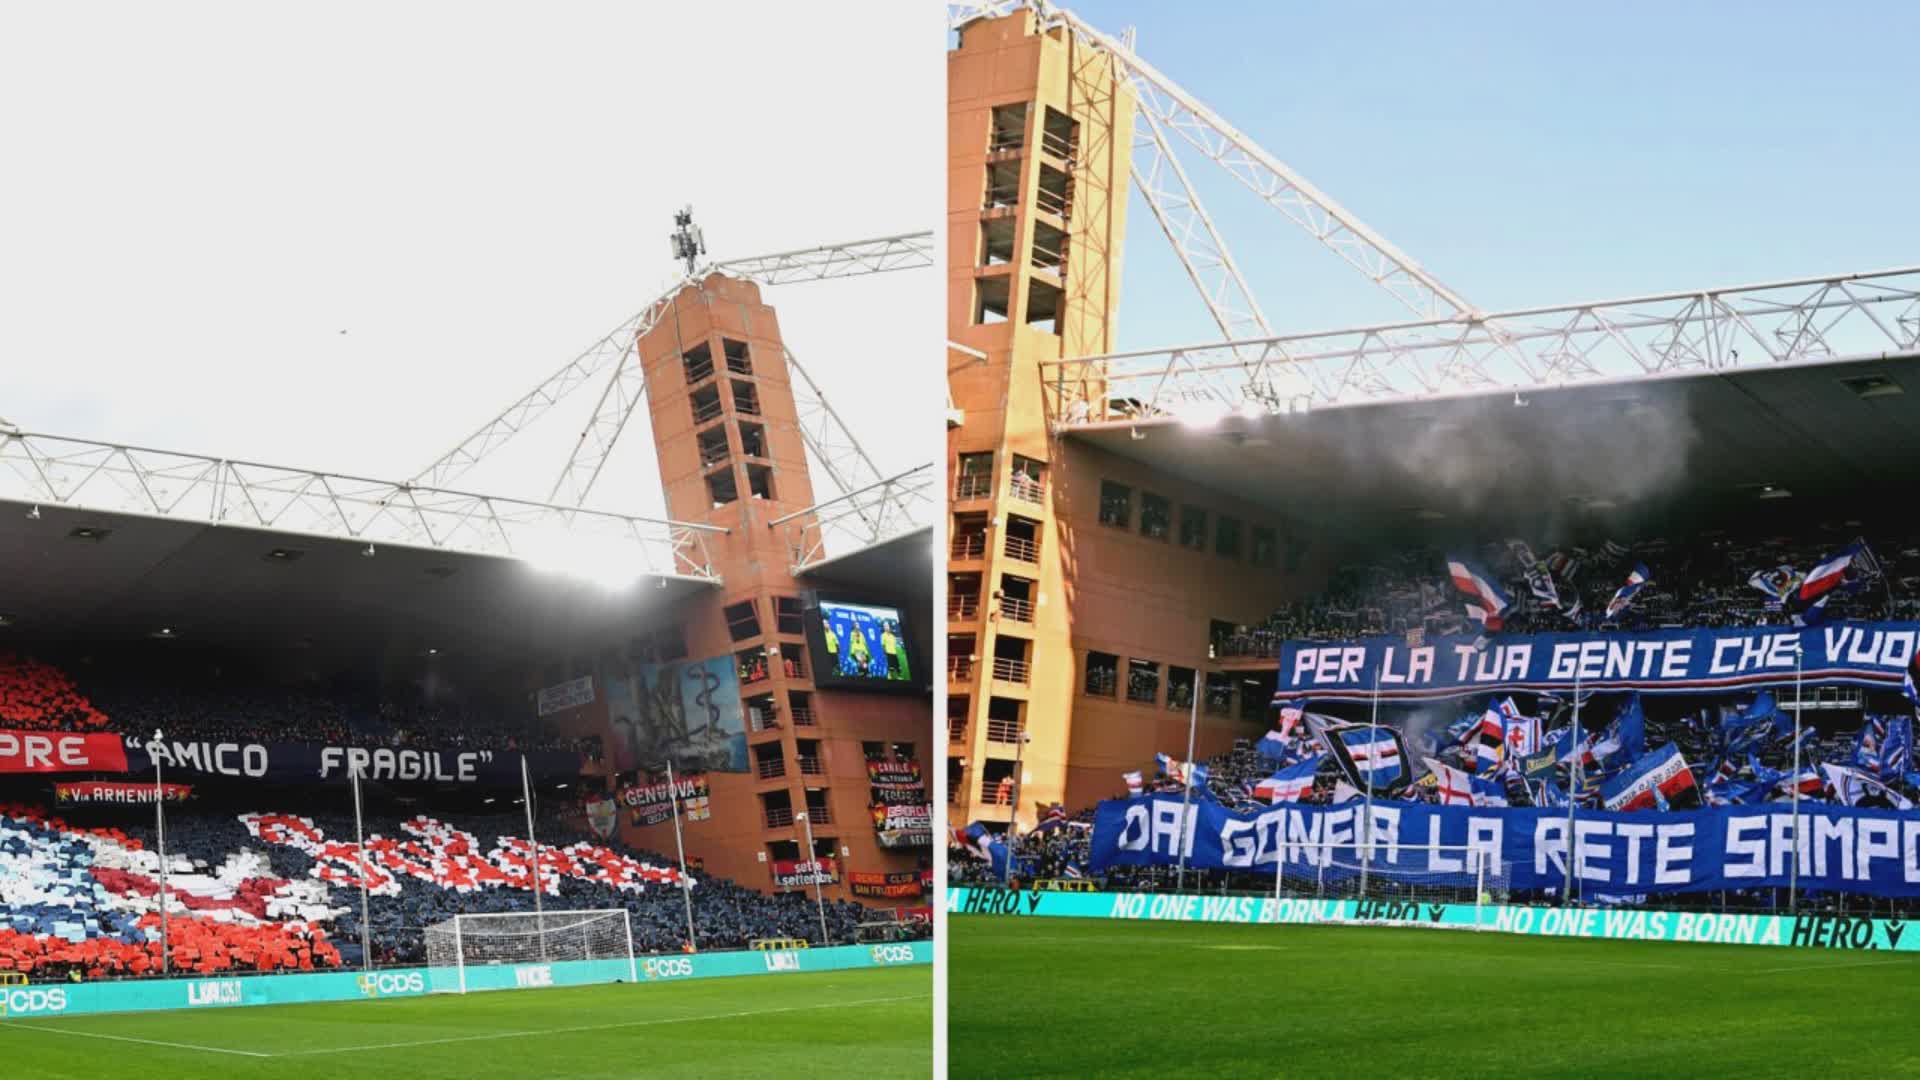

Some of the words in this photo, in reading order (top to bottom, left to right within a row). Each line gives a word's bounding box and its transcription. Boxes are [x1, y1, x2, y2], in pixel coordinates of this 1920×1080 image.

[1291, 647, 1366, 685] PER
[1380, 647, 1435, 684] LA
[1454, 644, 1532, 682] TUA
[1548, 640, 1693, 679] GENTE
[1709, 633, 1800, 675] CHE
[1824, 627, 1920, 668] VUO
[93, 787, 163, 803] ARMENIA
[1118, 800, 1199, 858] DAI
[1219, 803, 1401, 868] GONFIA
[1428, 814, 1504, 875] LA
[1533, 817, 1696, 885] RETE
[1110, 893, 1147, 918] NO
[1150, 894, 1200, 920] ONE
[1200, 896, 1255, 922] WAS
[1258, 898, 1324, 923] BORN
[1495, 906, 1533, 934] NO
[1540, 908, 1599, 937] ONE
[1604, 910, 1669, 940] WAS
[1674, 912, 1759, 944] BORN
[1759, 915, 1781, 945] A
[885, 945, 914, 961] CDS
[658, 958, 693, 977] CDS
[379, 972, 425, 994] CDS
[9, 988, 67, 1011] CDS
